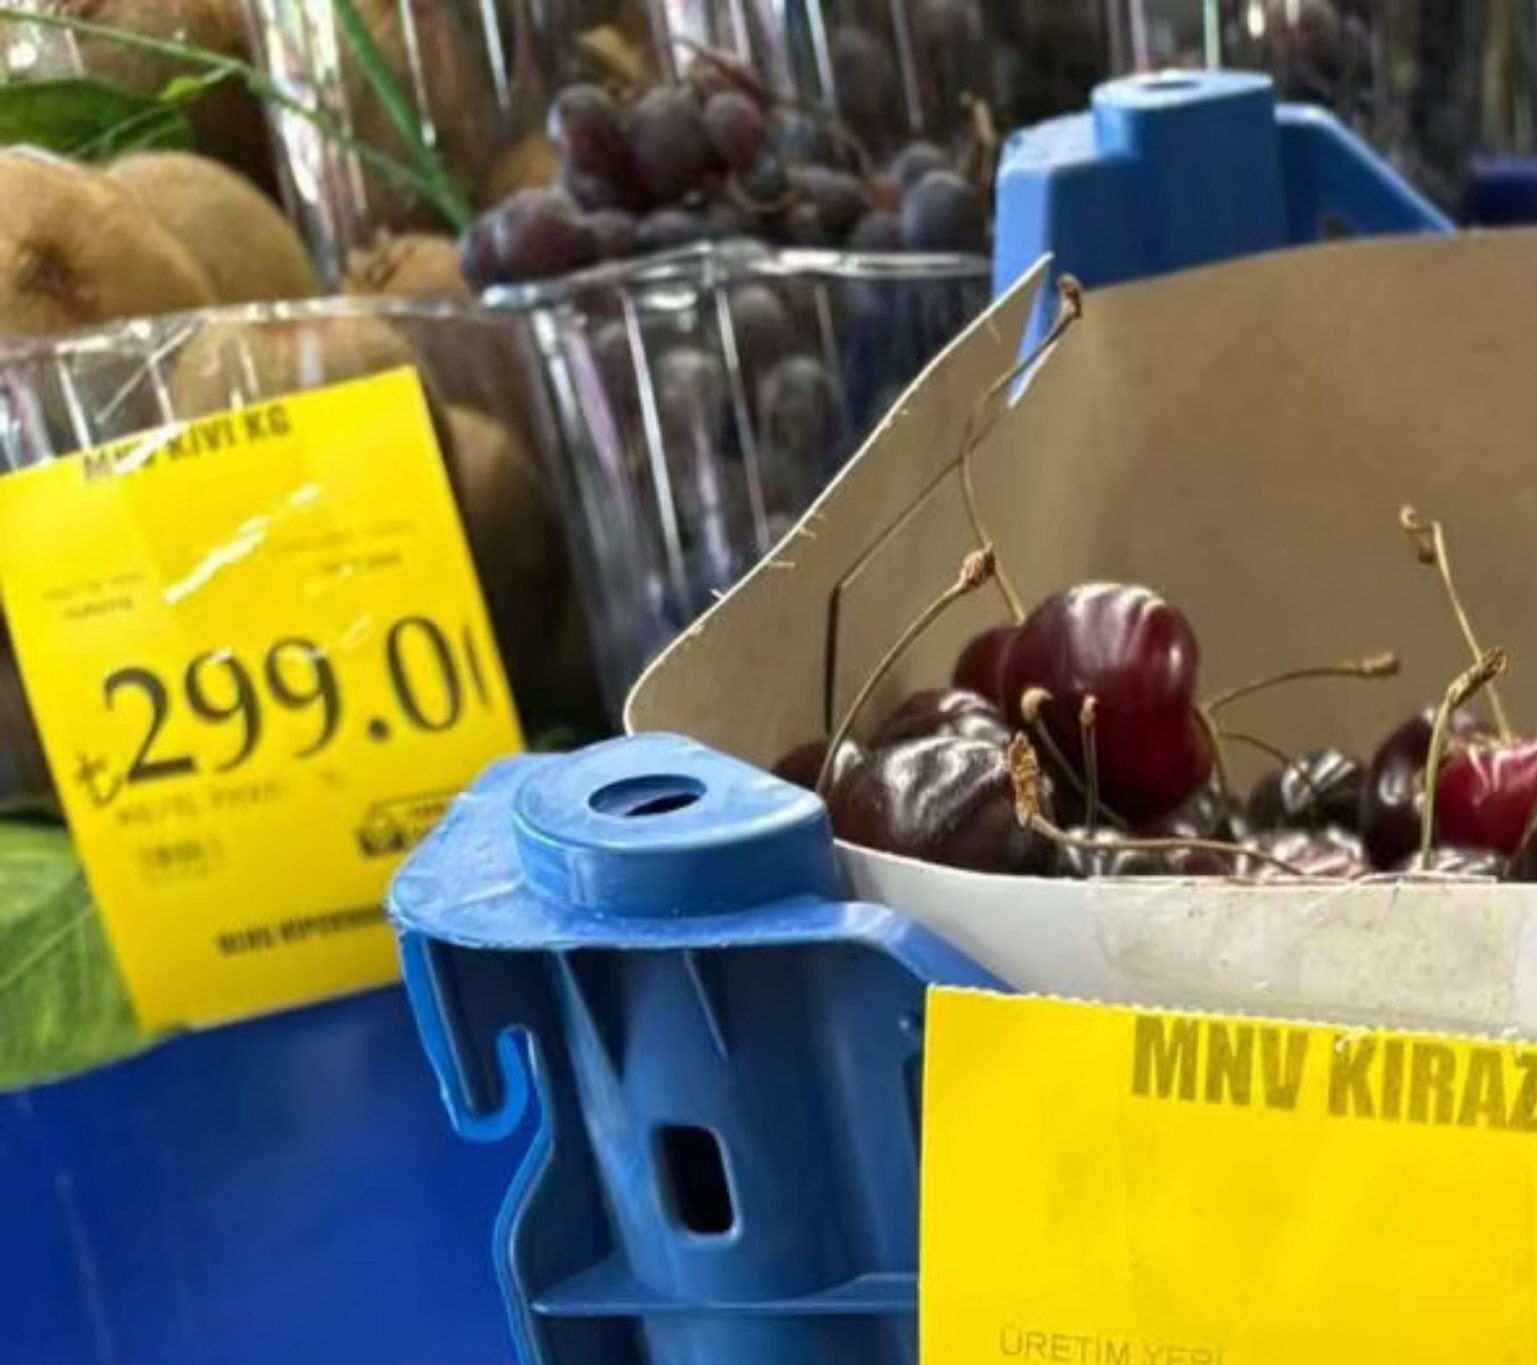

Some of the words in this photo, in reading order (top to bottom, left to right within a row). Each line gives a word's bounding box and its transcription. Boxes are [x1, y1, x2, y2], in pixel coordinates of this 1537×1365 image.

[244, 404, 290, 441] KG
[75, 613, 495, 806] ₺299.0
[1131, 1013, 1309, 1112] MNV
